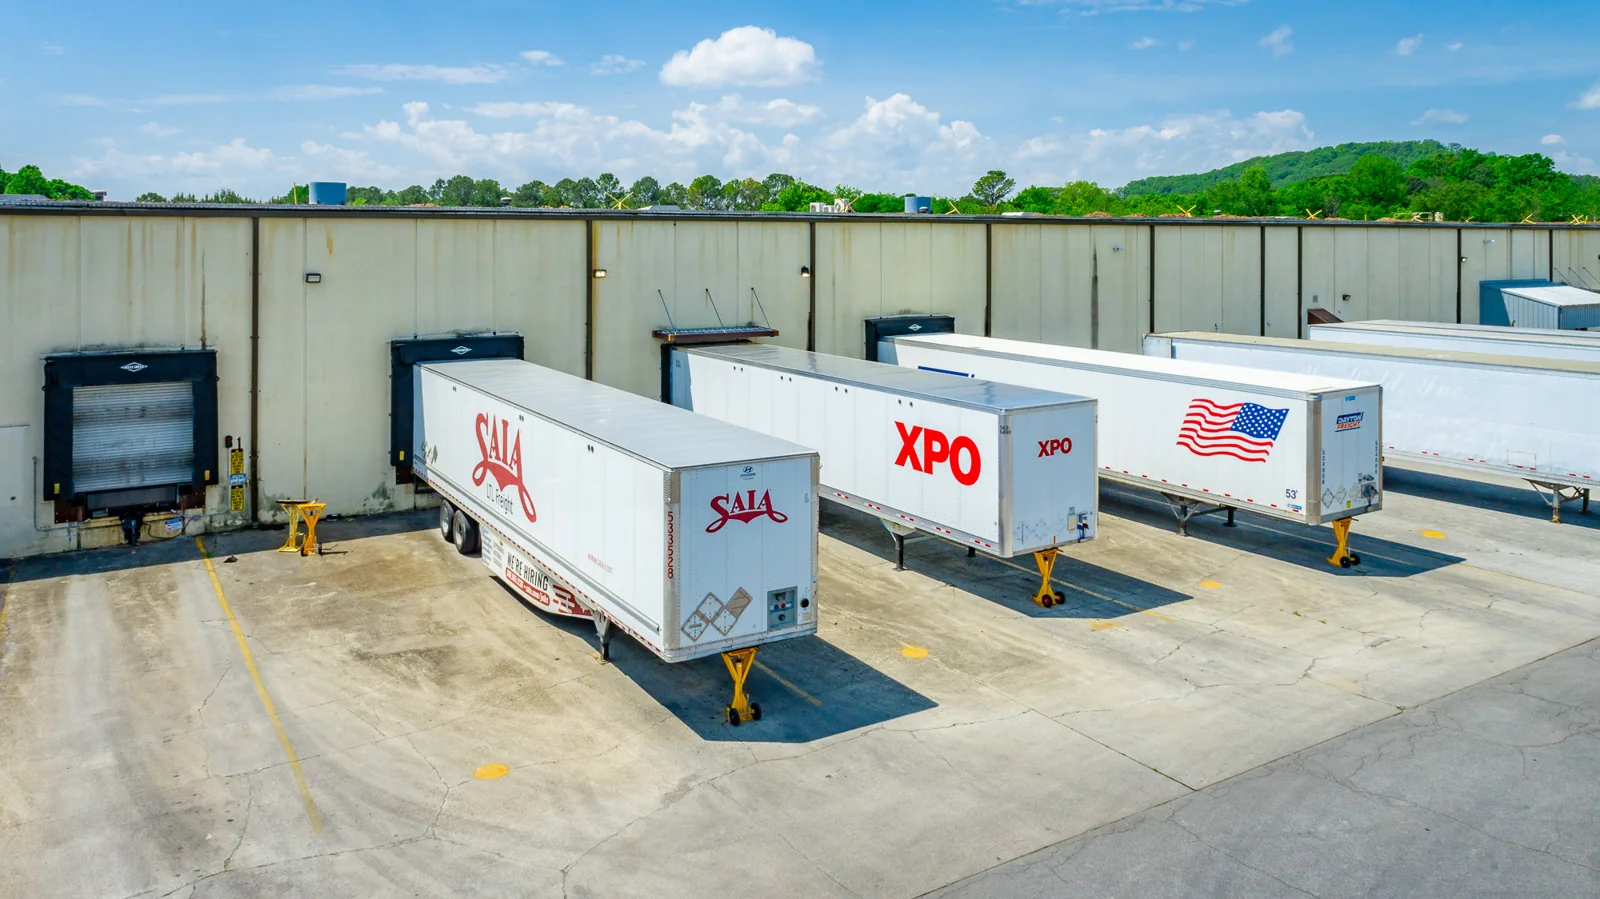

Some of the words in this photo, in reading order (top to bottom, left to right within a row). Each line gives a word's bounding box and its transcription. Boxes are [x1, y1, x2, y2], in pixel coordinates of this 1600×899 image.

[1336, 421, 1361, 429] FREIGHT
[1338, 414, 1362, 424] DAYTON
[894, 421, 982, 486] XPO
[1037, 437, 1073, 458] XPO
[472, 412, 537, 523] SAIA
[486, 482, 495, 502] LTL
[495, 487, 514, 515] Freight
[705, 488, 789, 533] SAIA
[507, 552, 523, 576] WE'RE
[523, 564, 549, 591] HIRING
